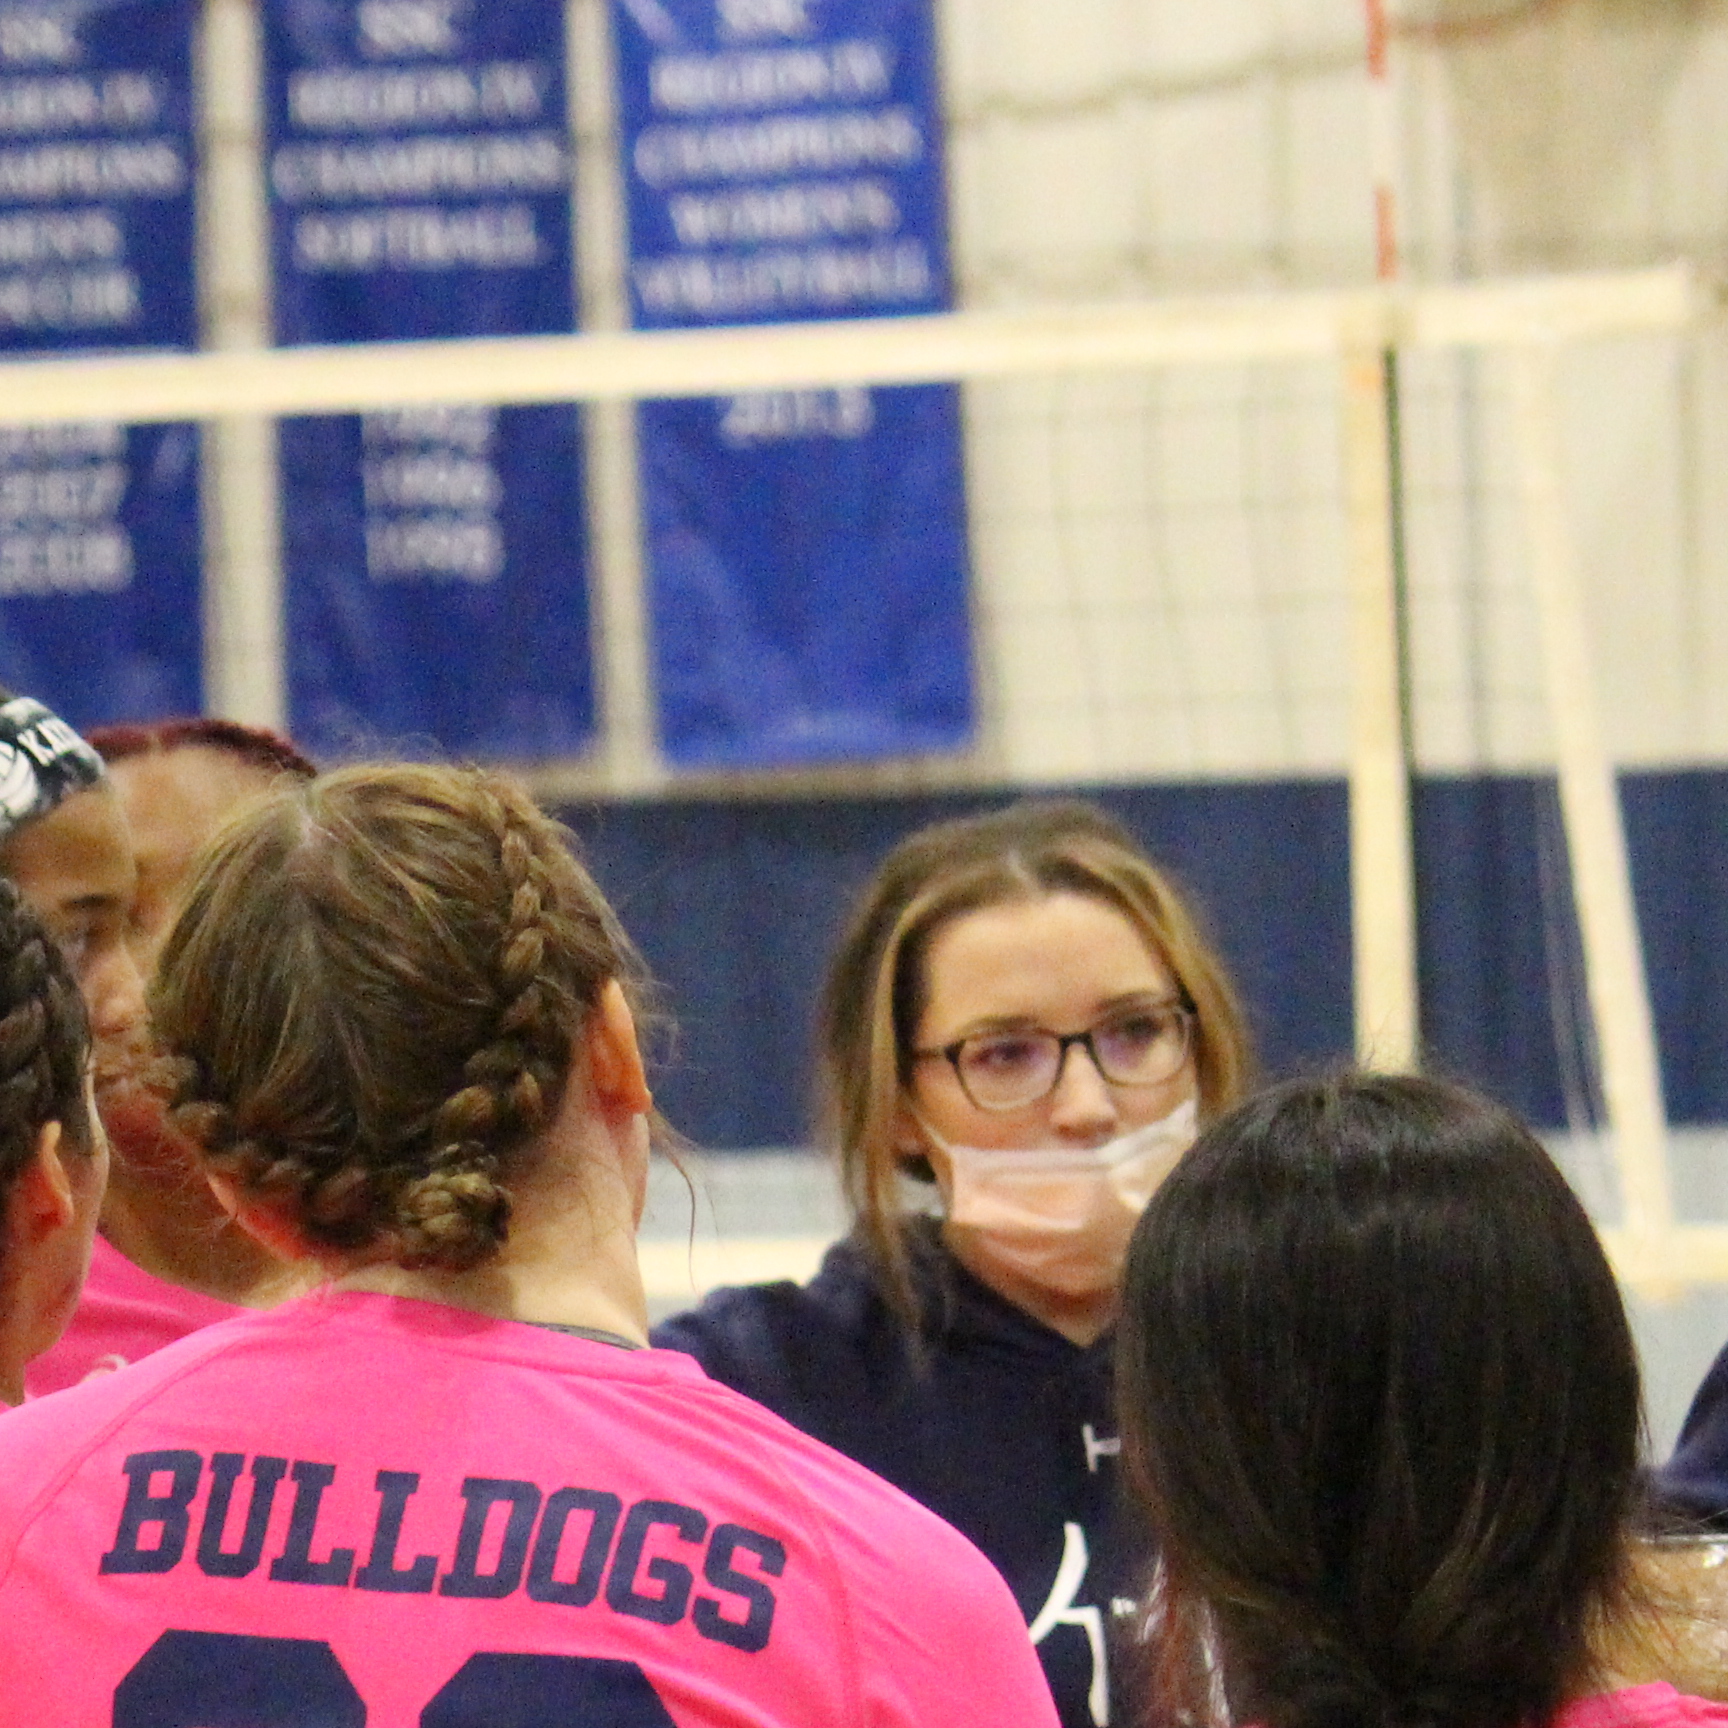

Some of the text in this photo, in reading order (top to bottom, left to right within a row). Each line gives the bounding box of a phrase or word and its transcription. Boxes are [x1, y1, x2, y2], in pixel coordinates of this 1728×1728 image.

[288, 67, 475, 130] REGION
[649, 52, 829, 113] REGION
[273, 134, 565, 200] CHAMPIONS
[634, 110, 924, 189] CHAMPIONS
[295, 202, 540, 270] SOFTBALL
[673, 184, 901, 247] WOMEN'S
[634, 237, 932, 310] VOLLEYBALL
[98, 1448, 787, 1654] BULLDOGS
